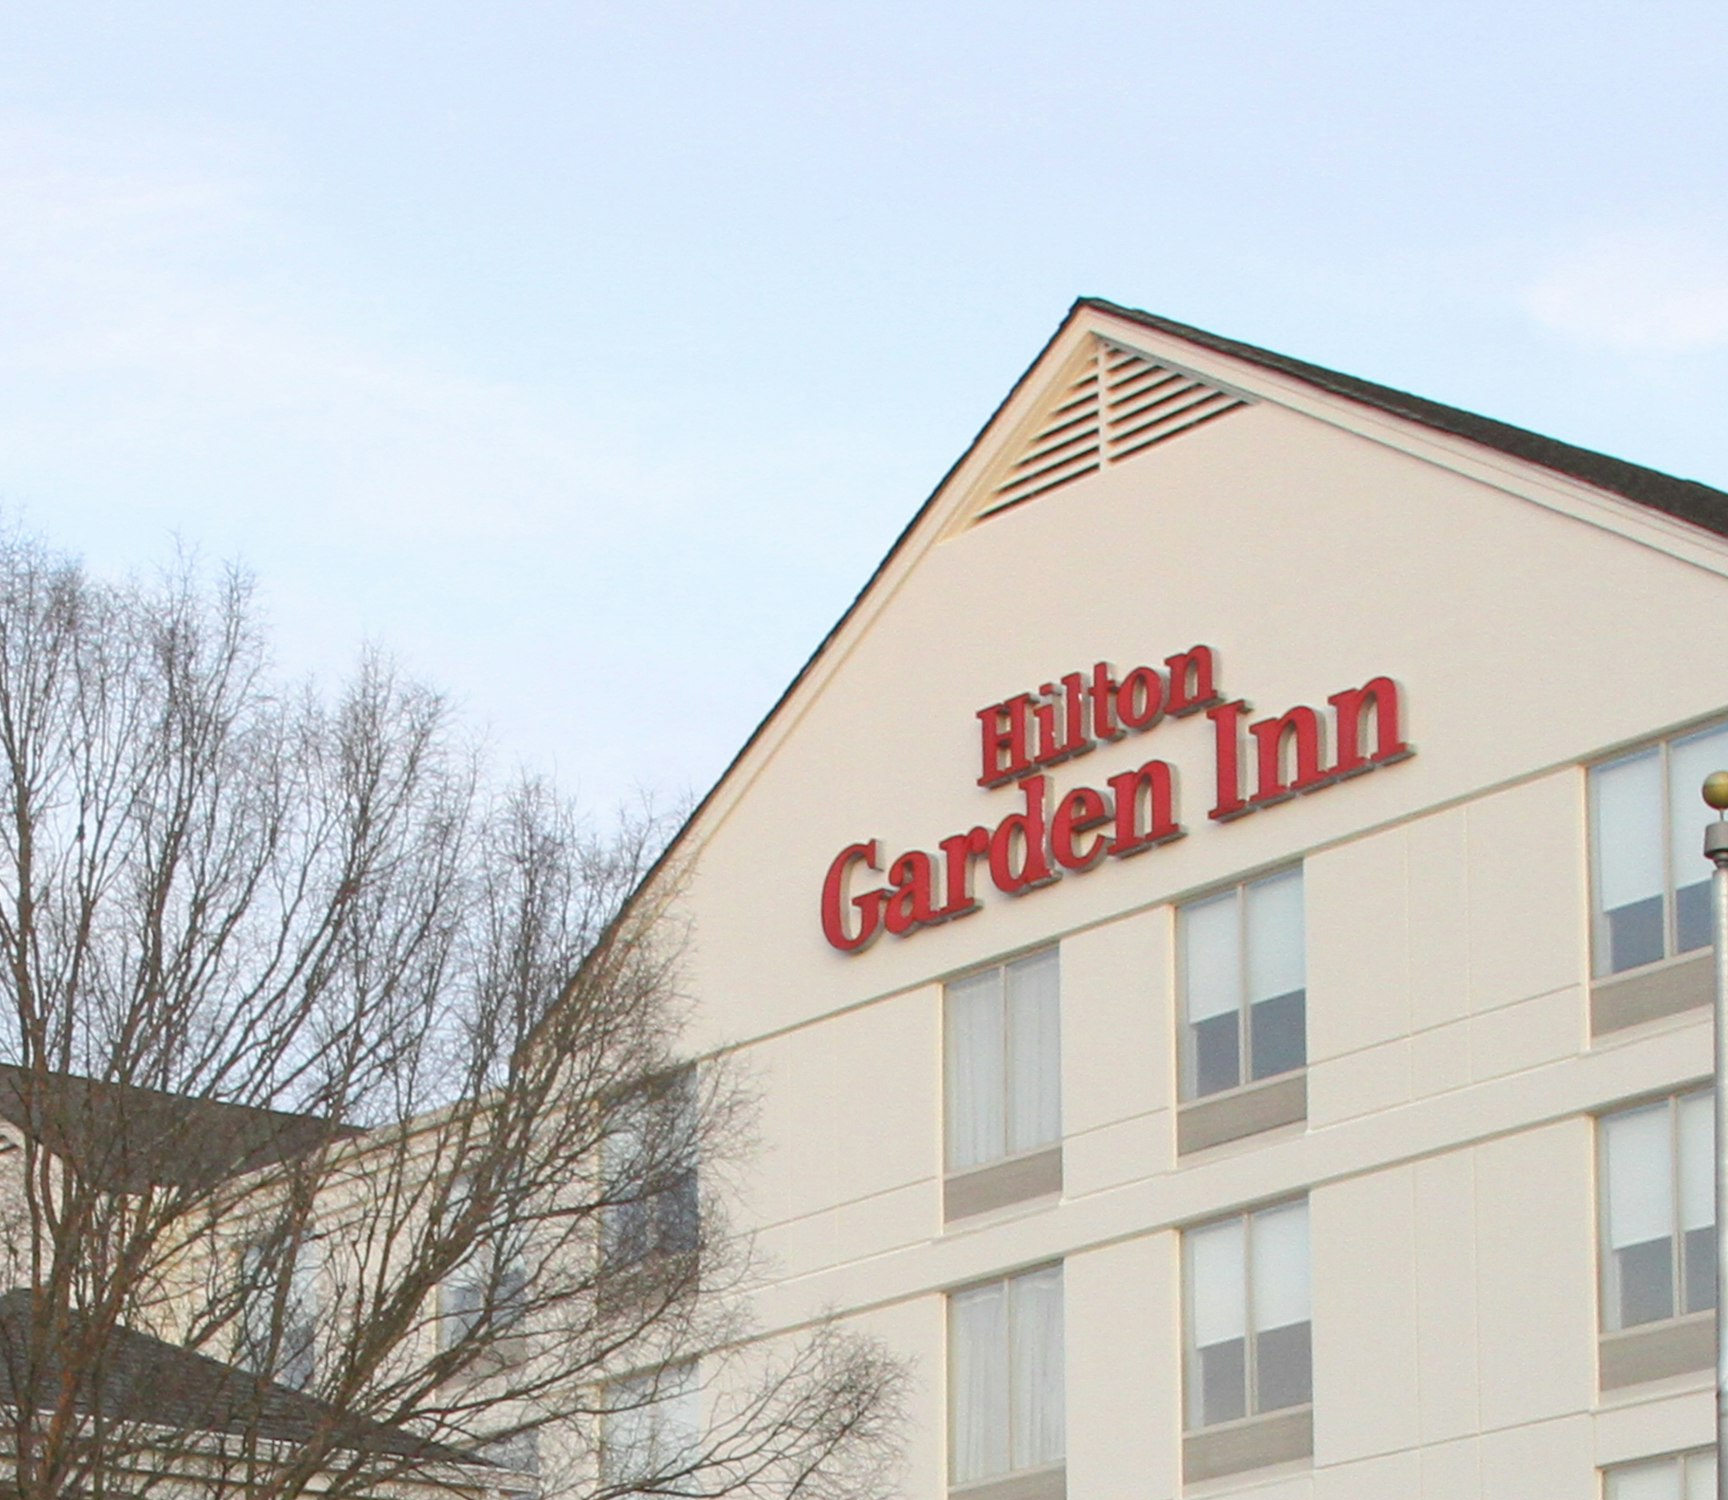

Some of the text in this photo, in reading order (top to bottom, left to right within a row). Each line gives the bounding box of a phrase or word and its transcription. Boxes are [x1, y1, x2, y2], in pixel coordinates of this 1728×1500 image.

[821, 676, 1415, 952] Garden Inn
[976, 644, 1223, 788] Hilton
